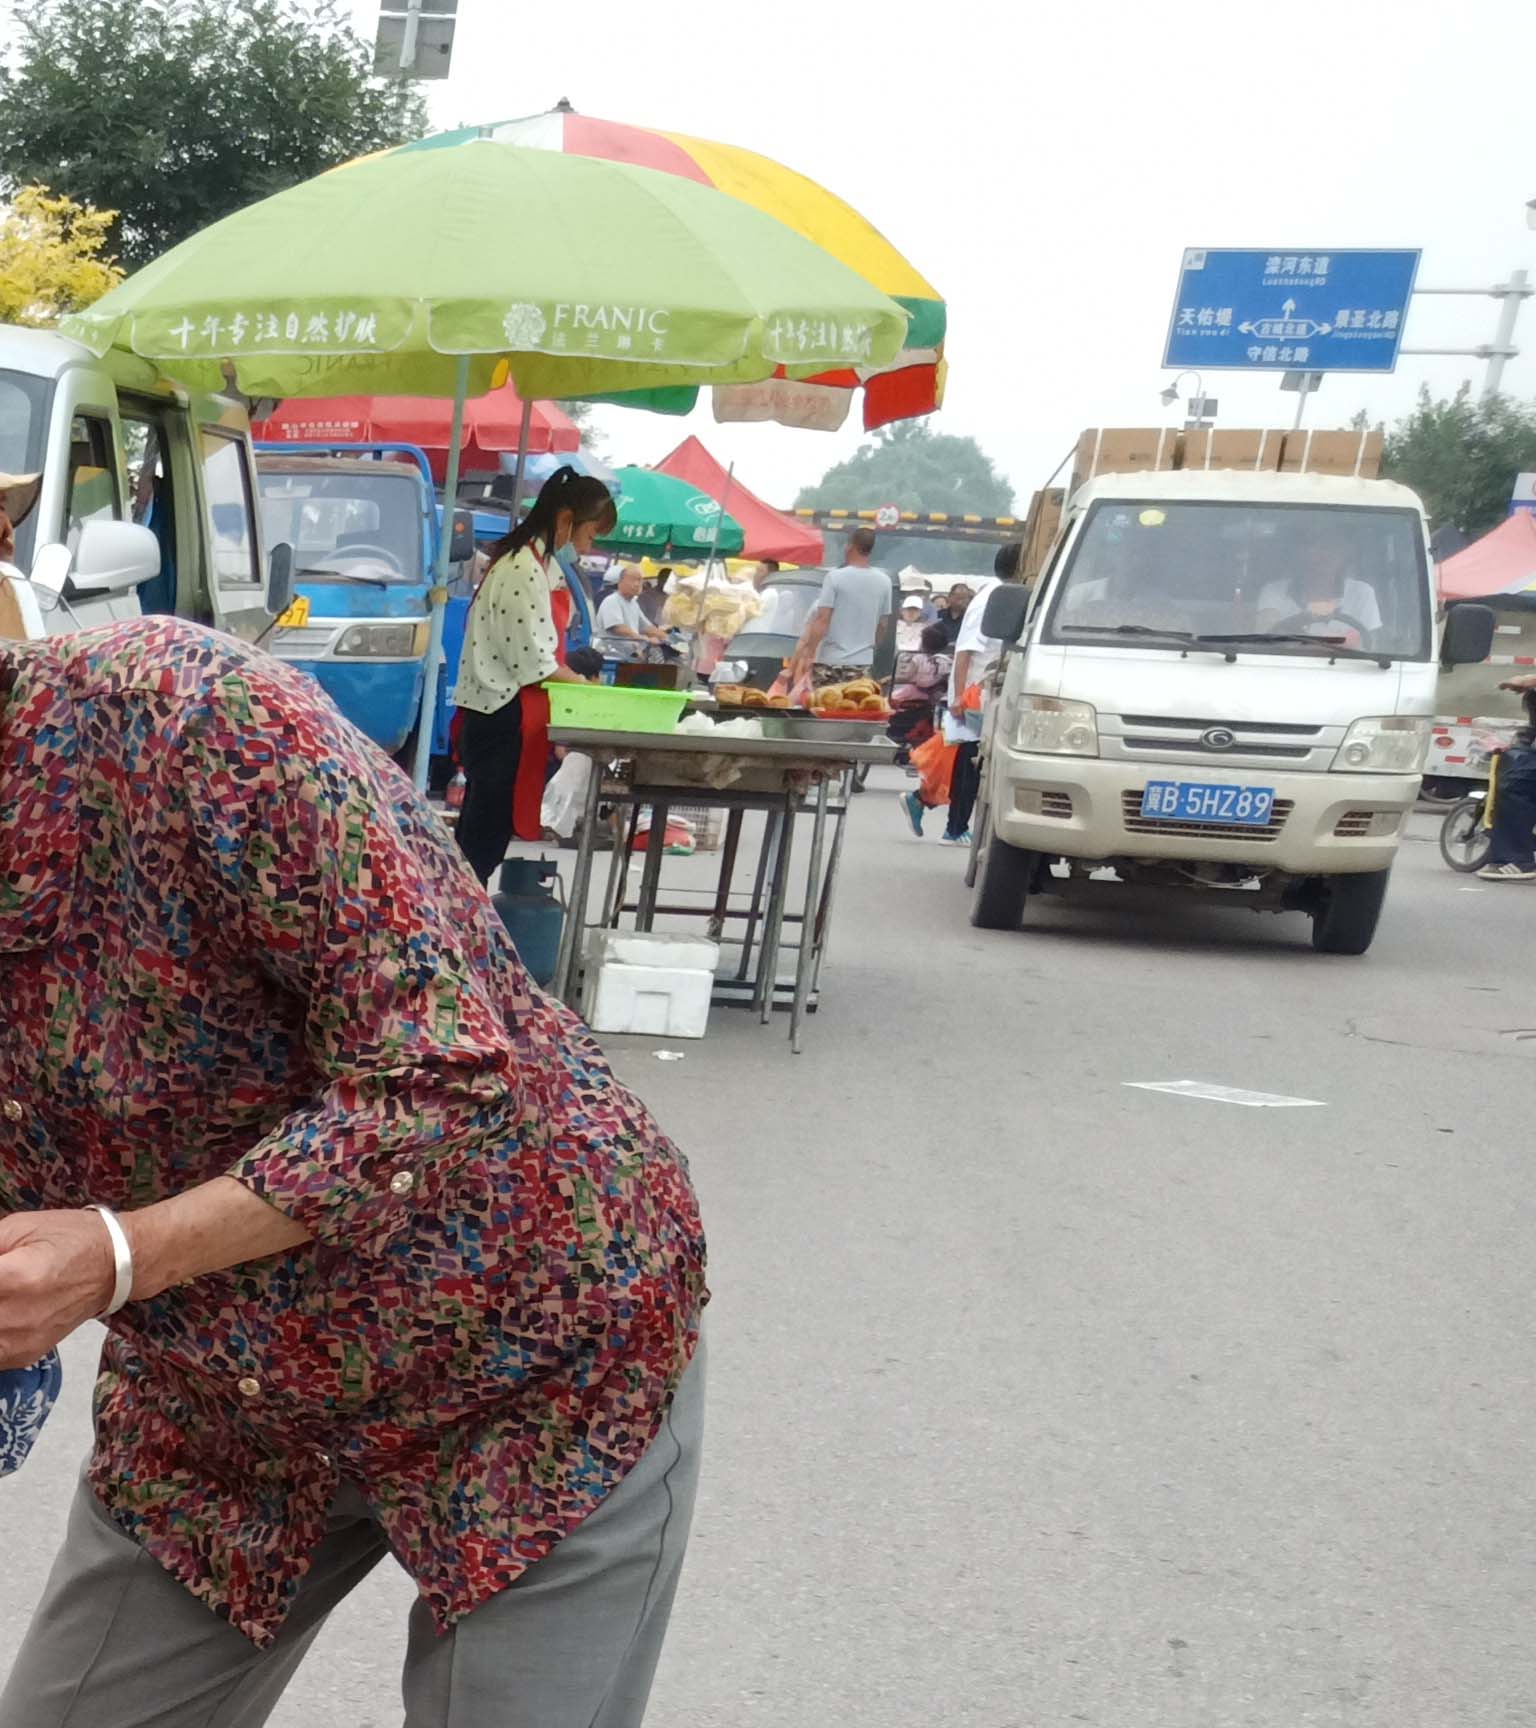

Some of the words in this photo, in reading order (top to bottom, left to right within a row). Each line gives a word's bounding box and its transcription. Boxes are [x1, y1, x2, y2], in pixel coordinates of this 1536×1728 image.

[169, 311, 377, 349] 十年专注自然护肤
[553, 303, 670, 334] FRANIC
